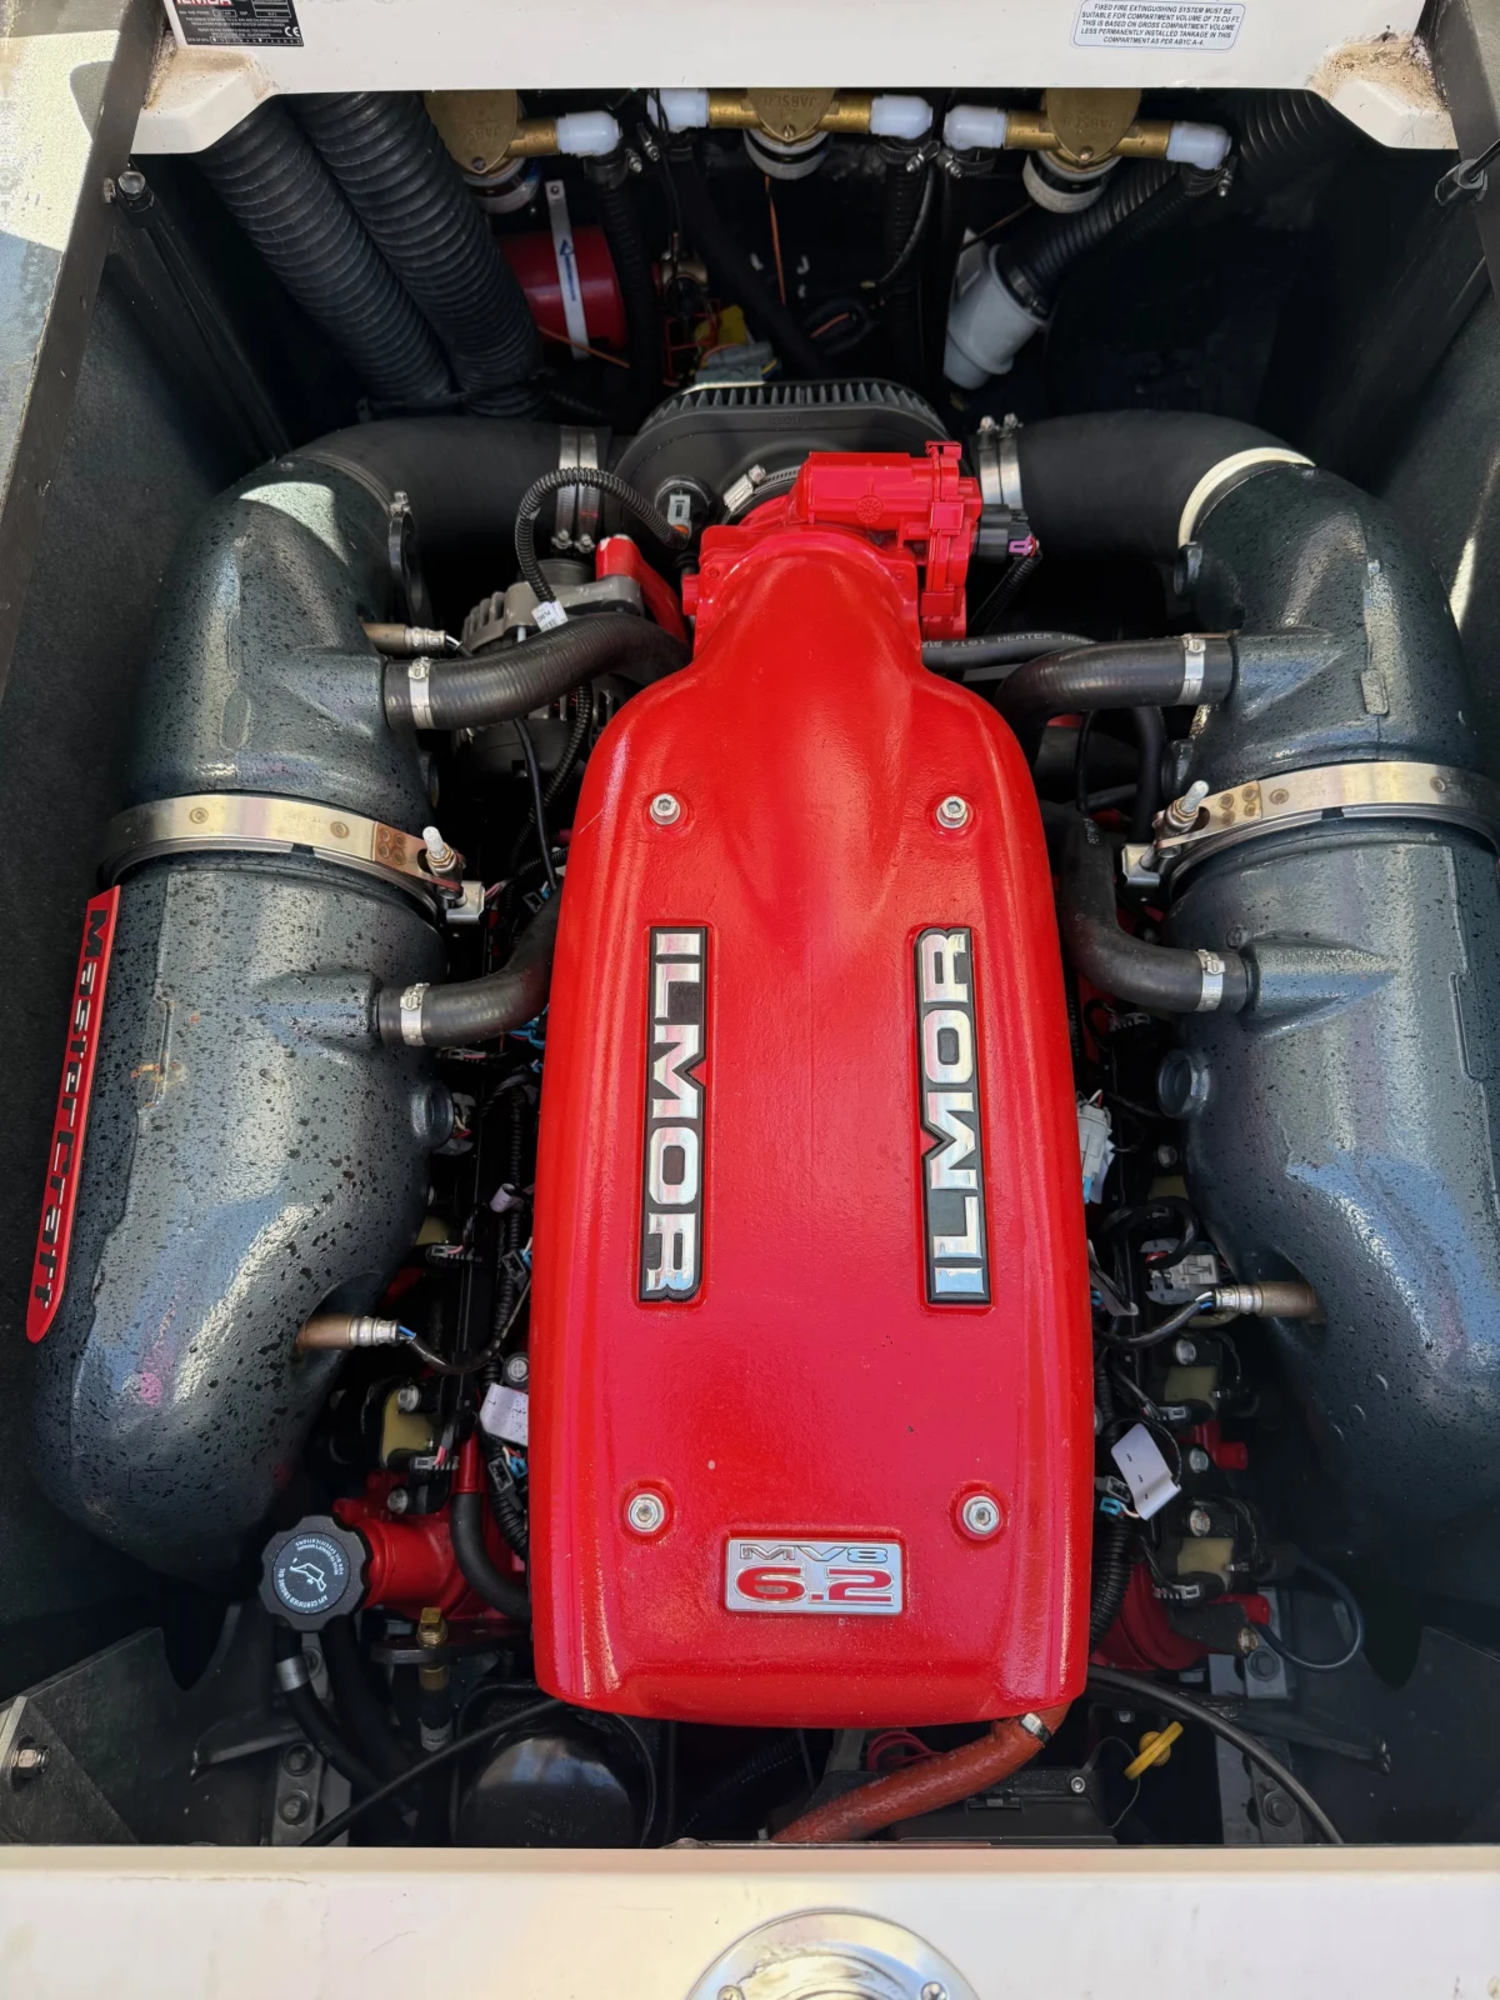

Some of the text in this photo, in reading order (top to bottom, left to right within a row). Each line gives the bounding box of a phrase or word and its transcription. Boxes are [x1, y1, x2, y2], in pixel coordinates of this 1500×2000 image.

[1094, 3, 1113, 11] FIXED
[1129, 5, 1177, 13] EXTINGUISHING
[1081, 11, 1112, 19] SUITABLE
[1112, 12, 1126, 20] FOR
[1127, 13, 1175, 21] COMPARTMENT
[1082, 19, 1096, 27] THIS
[1160, 22, 1208, 30] COMPARTMENT
[1098, 28, 1144, 36] PERMANENTLY
[1144, 29, 1179, 37] INSTALLED
[1102, 36, 1150, 44] COMPARTMENT
[996, 633, 1053, 643] HEATER
[34, 908, 108, 1310] MasterCraft
[645, 930, 705, 1296] ILMOR
[921, 932, 988, 1296] ILMOR
[739, 1543, 888, 1563] MV8
[734, 1564, 895, 1606] 6.2
[289, 1596, 318, 1608] CERTIFIED
[318, 1594, 328, 1604] API
